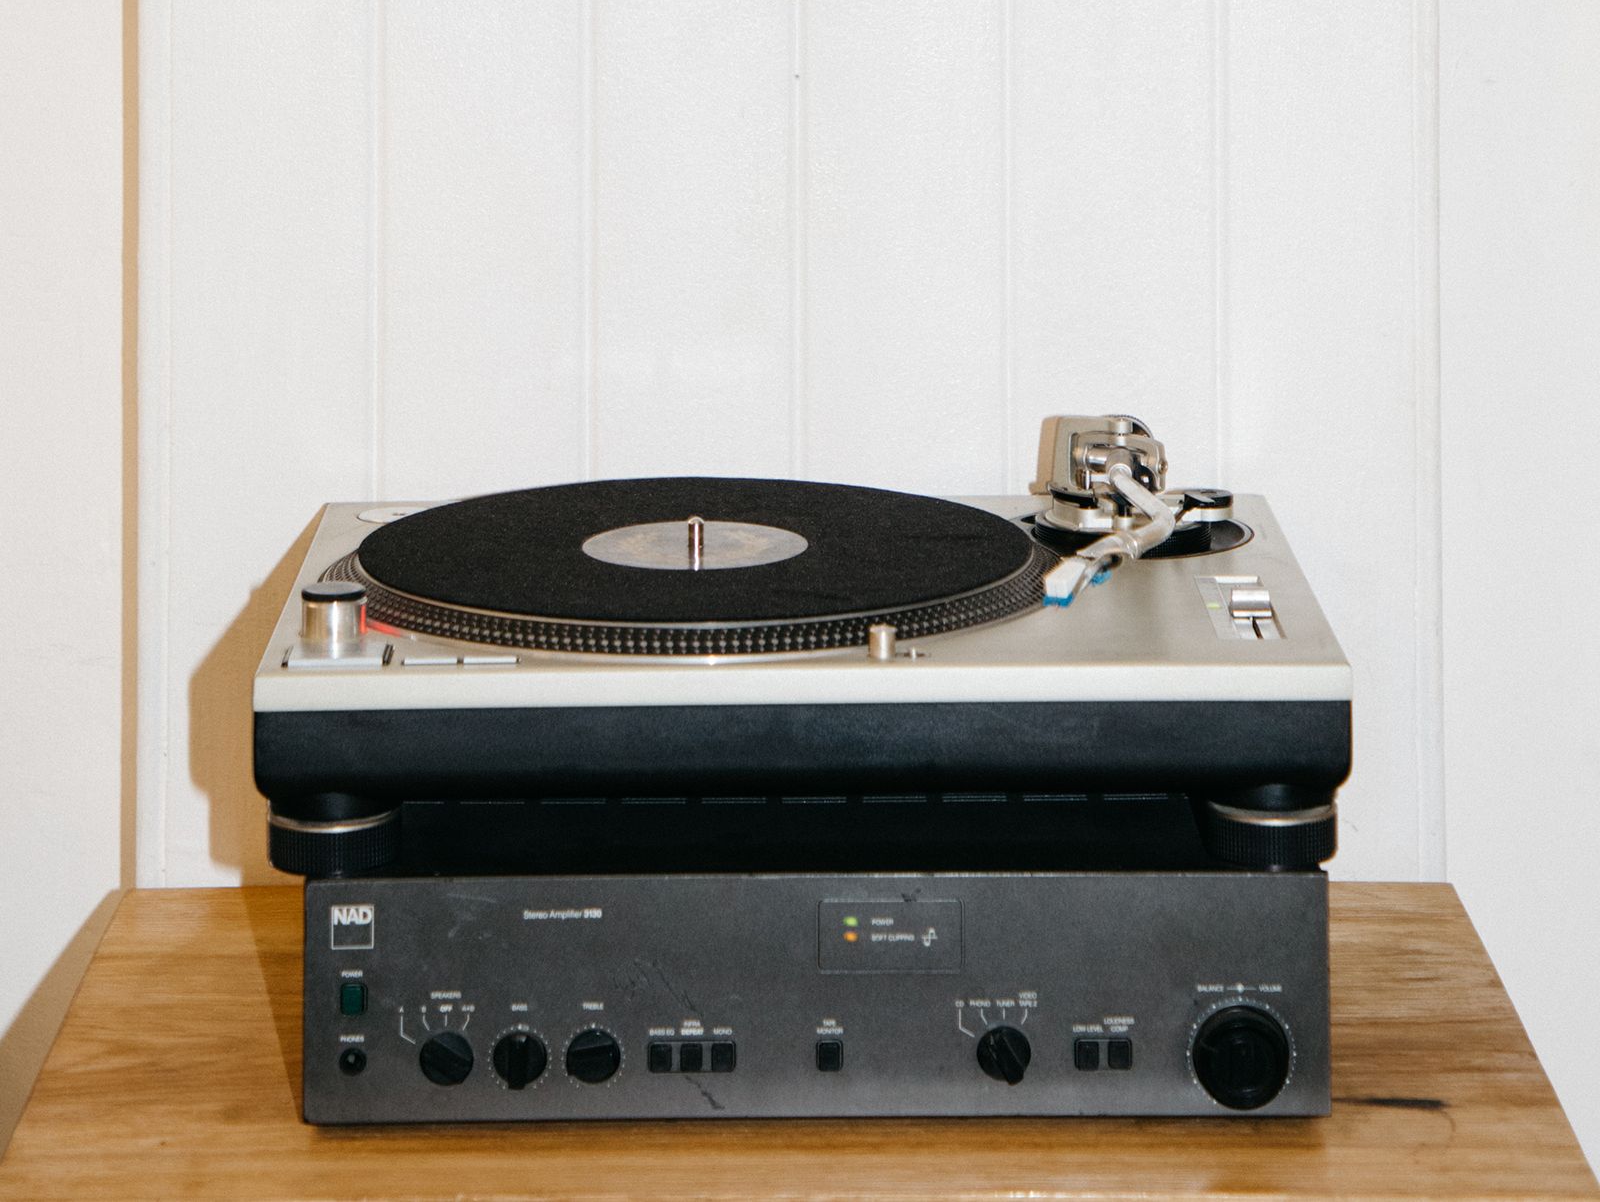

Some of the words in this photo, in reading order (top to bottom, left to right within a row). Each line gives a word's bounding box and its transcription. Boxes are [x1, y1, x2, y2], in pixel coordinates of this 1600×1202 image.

[333, 908, 373, 926] NAD
[871, 918, 893, 926] POWER
[341, 969, 363, 978] POWER
